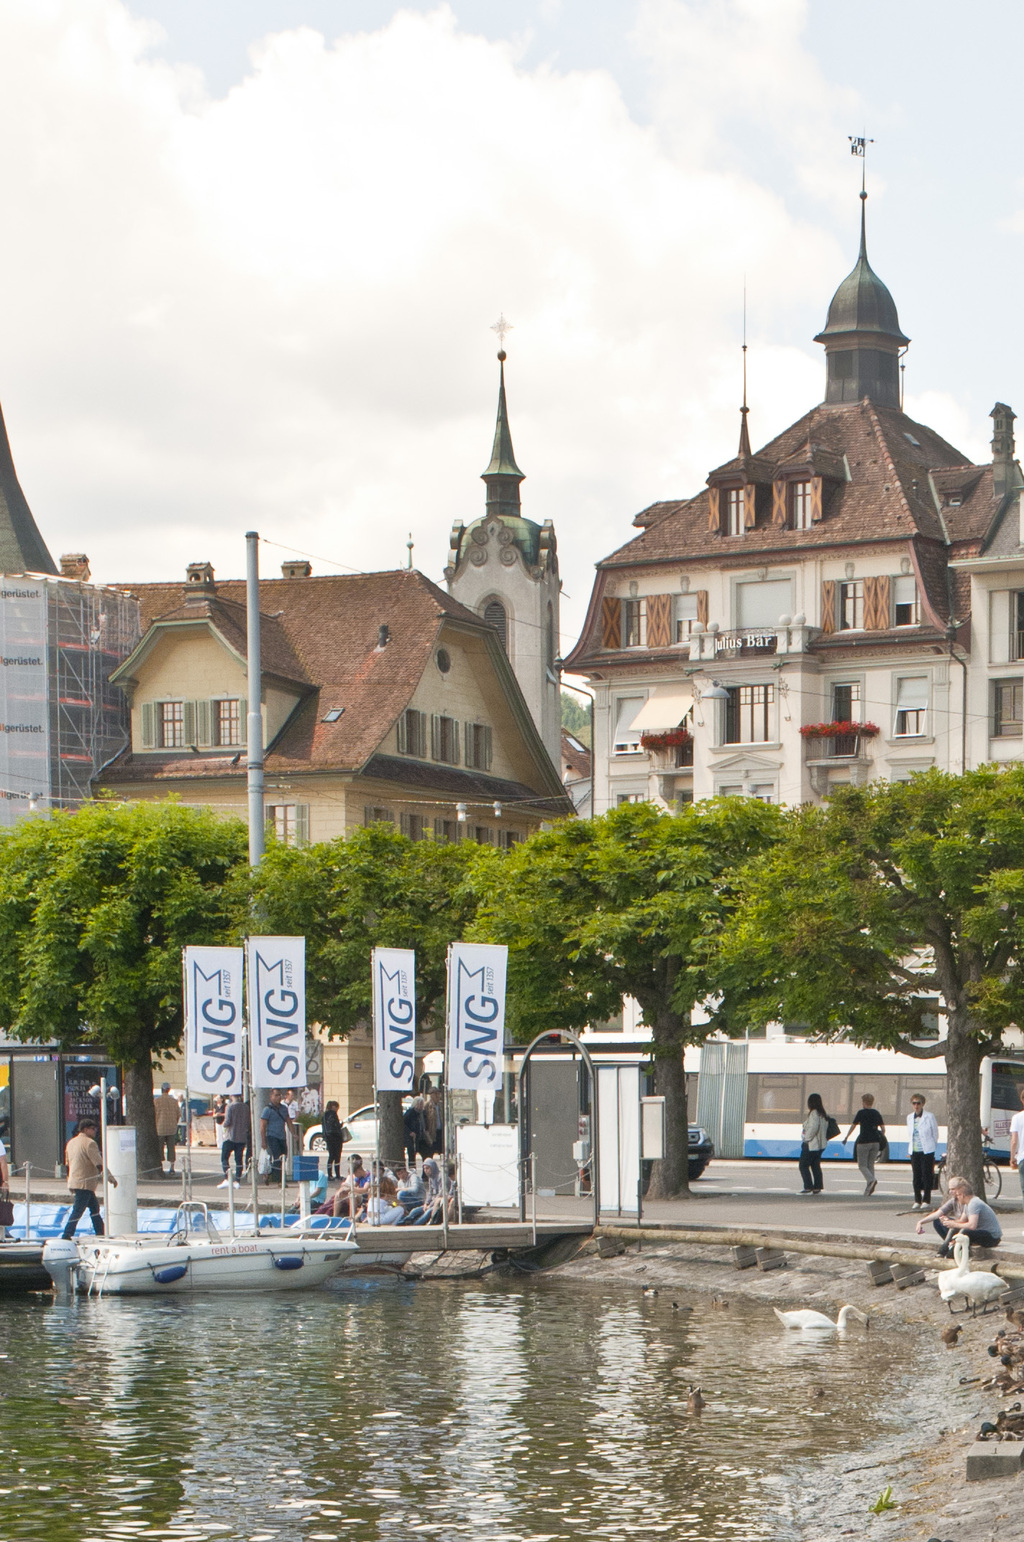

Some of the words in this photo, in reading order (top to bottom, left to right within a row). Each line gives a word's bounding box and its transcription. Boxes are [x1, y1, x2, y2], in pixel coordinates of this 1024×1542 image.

[714, 636, 743, 654] Julius
[284, 958, 293, 975] 1357
[486, 966, 494, 980] 1357
[222, 969, 232, 985] 1357
[400, 969, 408, 984] 1357
[201, 997, 237, 1088] SNG
[264, 988, 300, 1080] SNG
[387, 997, 414, 1084] SNG
[463, 994, 499, 1084] SNG
[211, 1246, 229, 1255] rent
[238, 1244, 258, 1253] boat
